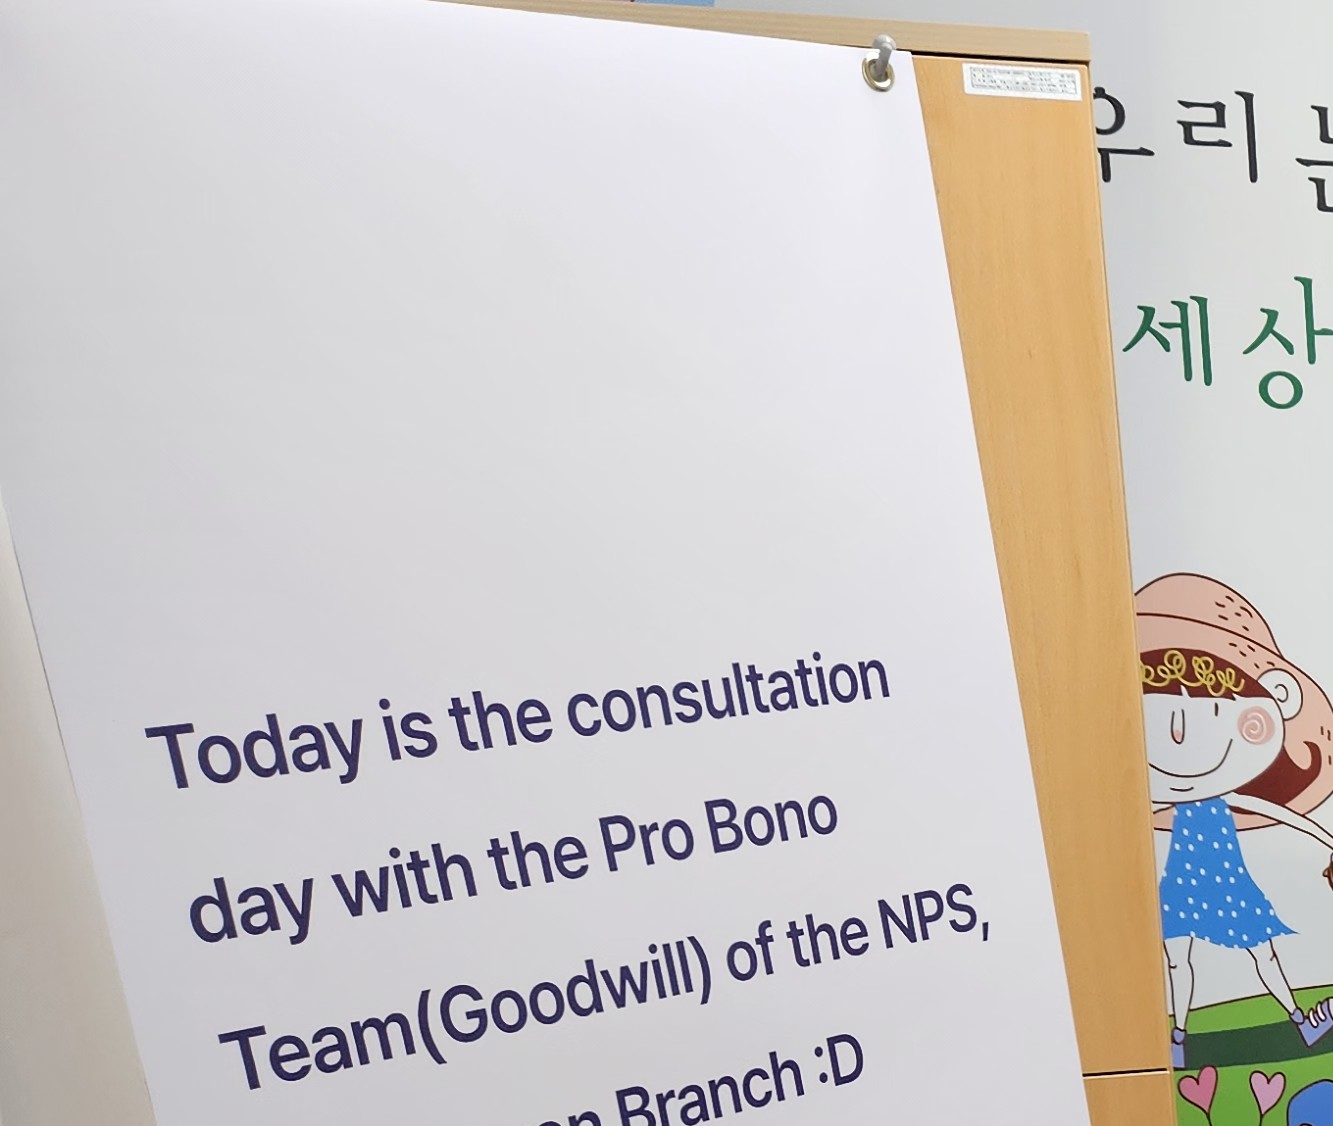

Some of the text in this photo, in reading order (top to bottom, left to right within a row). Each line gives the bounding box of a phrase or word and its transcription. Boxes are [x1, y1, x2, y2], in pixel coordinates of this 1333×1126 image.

[143, 650, 891, 790] Today is the consultation
[188, 794, 839, 947] day with the Pro Bono
[216, 882, 990, 1092] Team(Goodwill) of the NPS,
[813, 1032, 865, 1088] :D
